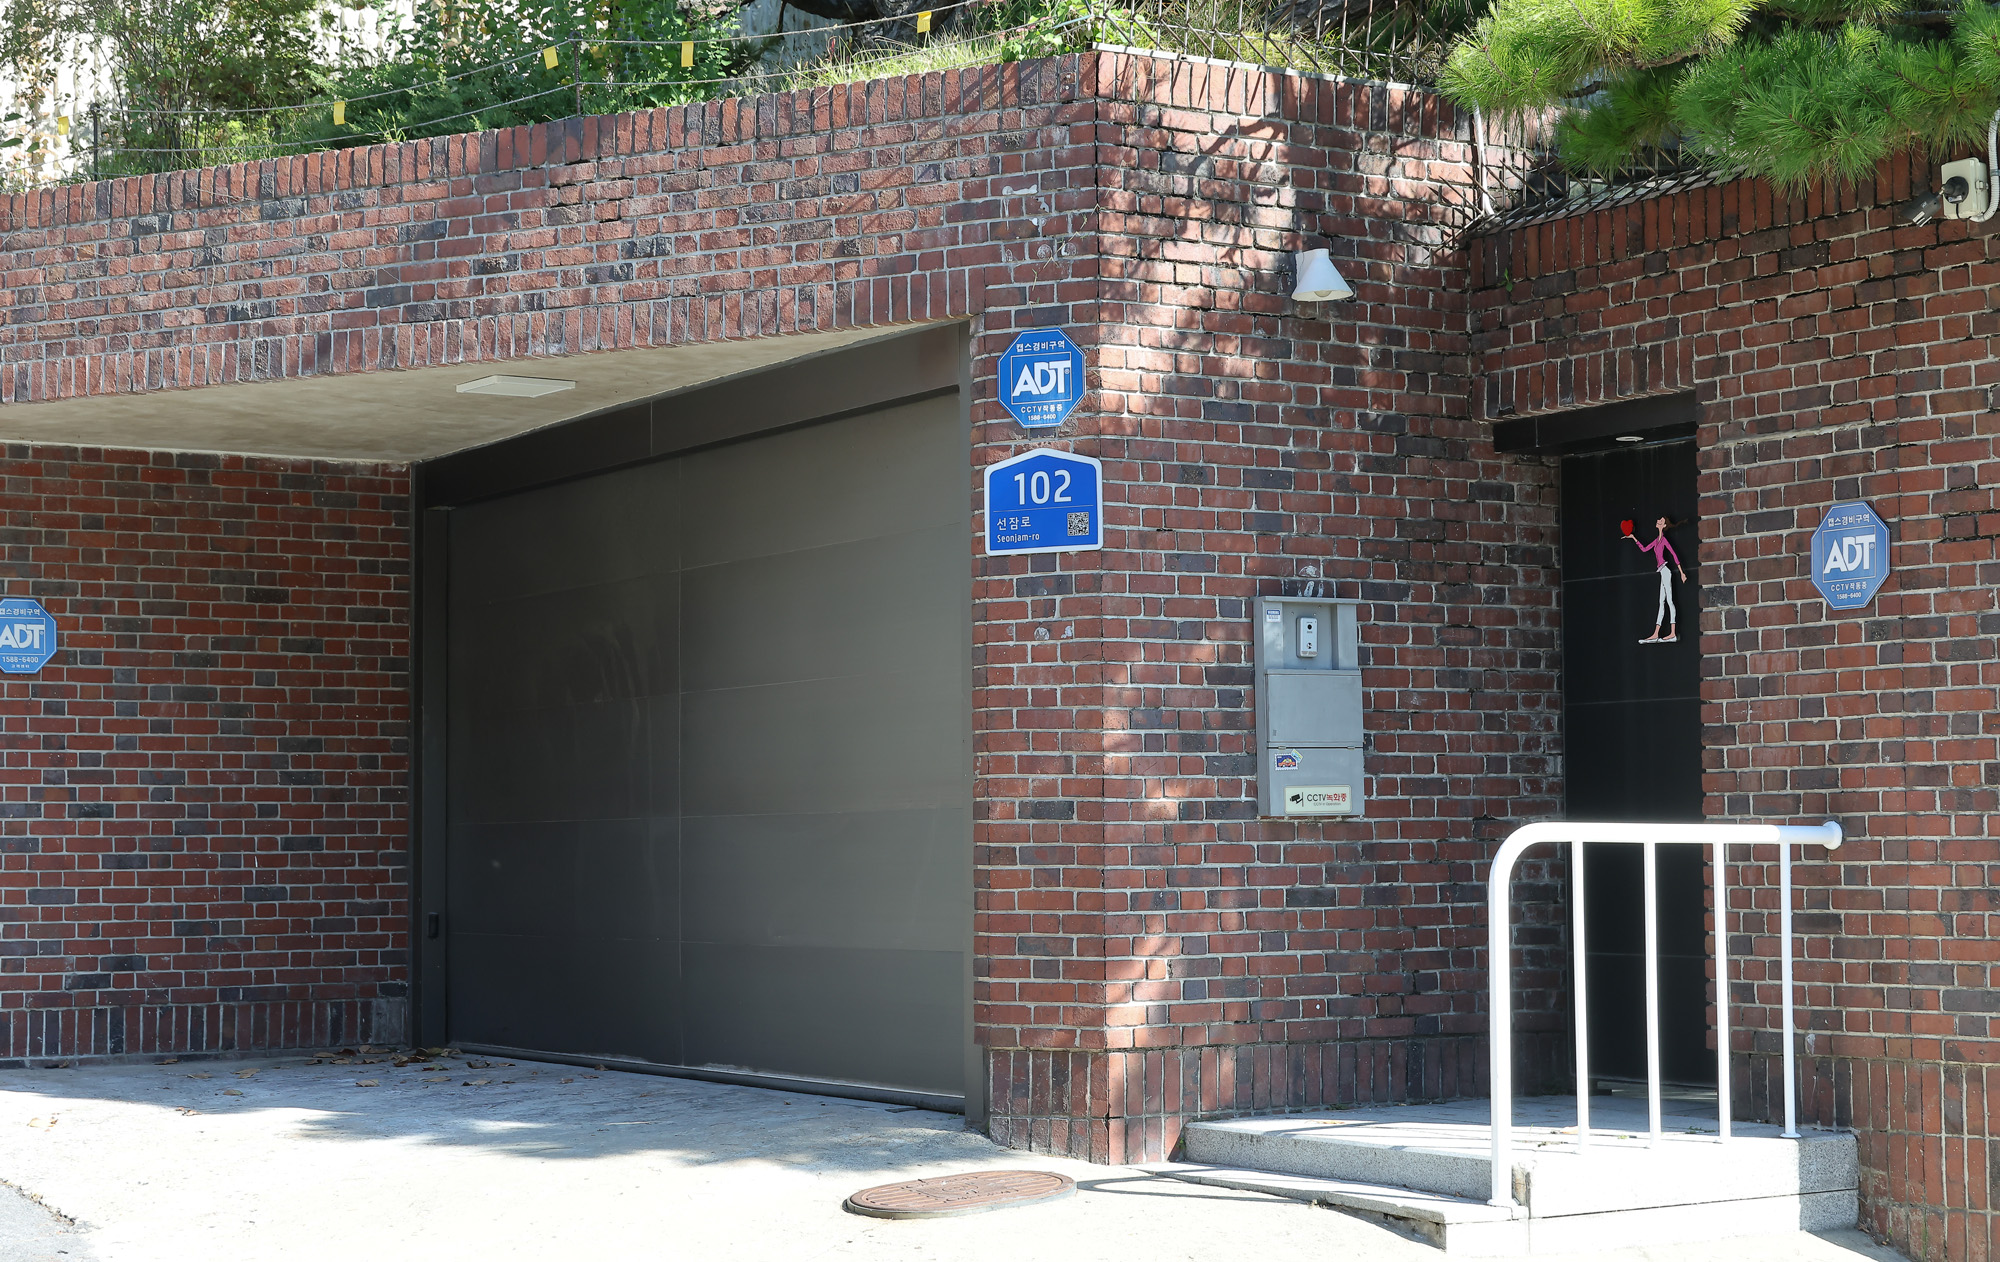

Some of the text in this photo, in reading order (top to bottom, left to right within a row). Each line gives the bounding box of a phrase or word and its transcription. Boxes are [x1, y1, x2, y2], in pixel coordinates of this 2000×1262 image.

[1016, 340, 1065, 352] 캡스경비구역
[1012, 360, 1071, 396] ADT
[1021, 404, 1063, 413] CCTV작동중
[1014, 469, 1072, 505] 102
[997, 516, 1031, 531] 선잠로
[1828, 513, 1870, 527] 캡스경비구역
[997, 533, 1040, 543] Seonjam-ro
[1823, 534, 1876, 574] ADT
[1830, 581, 1868, 592] CCTV작동중
[0, 624, 45, 649] ADT
[1306, 793, 1347, 802] CCTV녹화중
